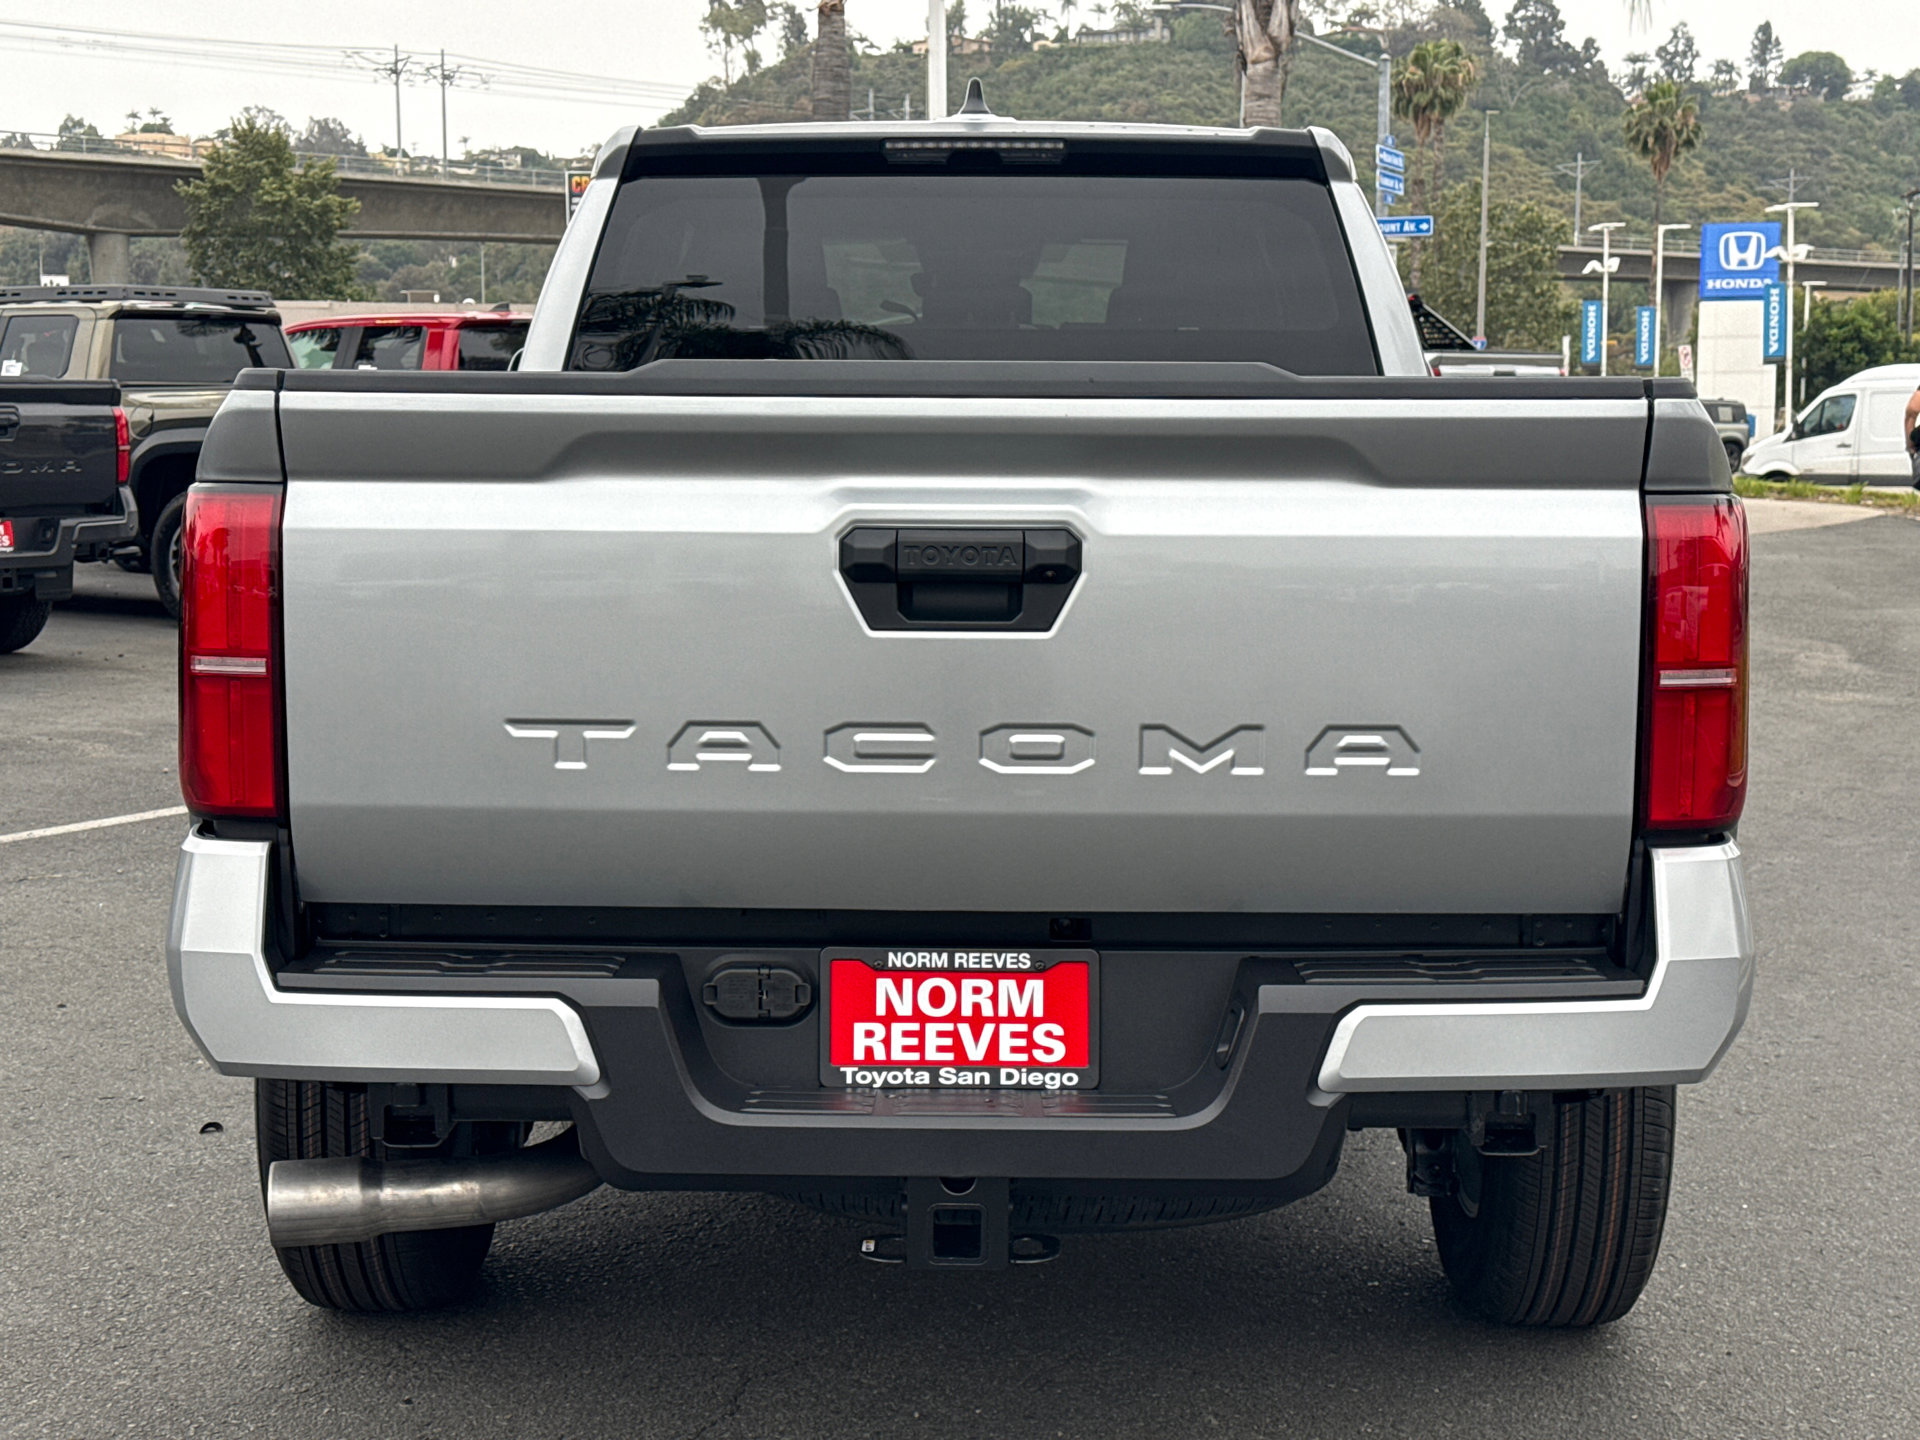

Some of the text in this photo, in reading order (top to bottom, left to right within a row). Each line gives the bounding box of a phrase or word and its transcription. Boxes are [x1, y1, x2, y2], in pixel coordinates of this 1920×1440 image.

[1586, 304, 1597, 361] HONDA
[1640, 311, 1651, 364] HONDA
[1769, 288, 1780, 355] HONDA
[903, 545, 1017, 566] TOYOTA
[503, 718, 1420, 776] TACOMA
[888, 952, 1031, 969] NORM REEVES
[875, 977, 1044, 1018] NORM
[853, 1022, 1066, 1063] REEVES
[840, 1067, 1079, 1090] Toyota San Diego
